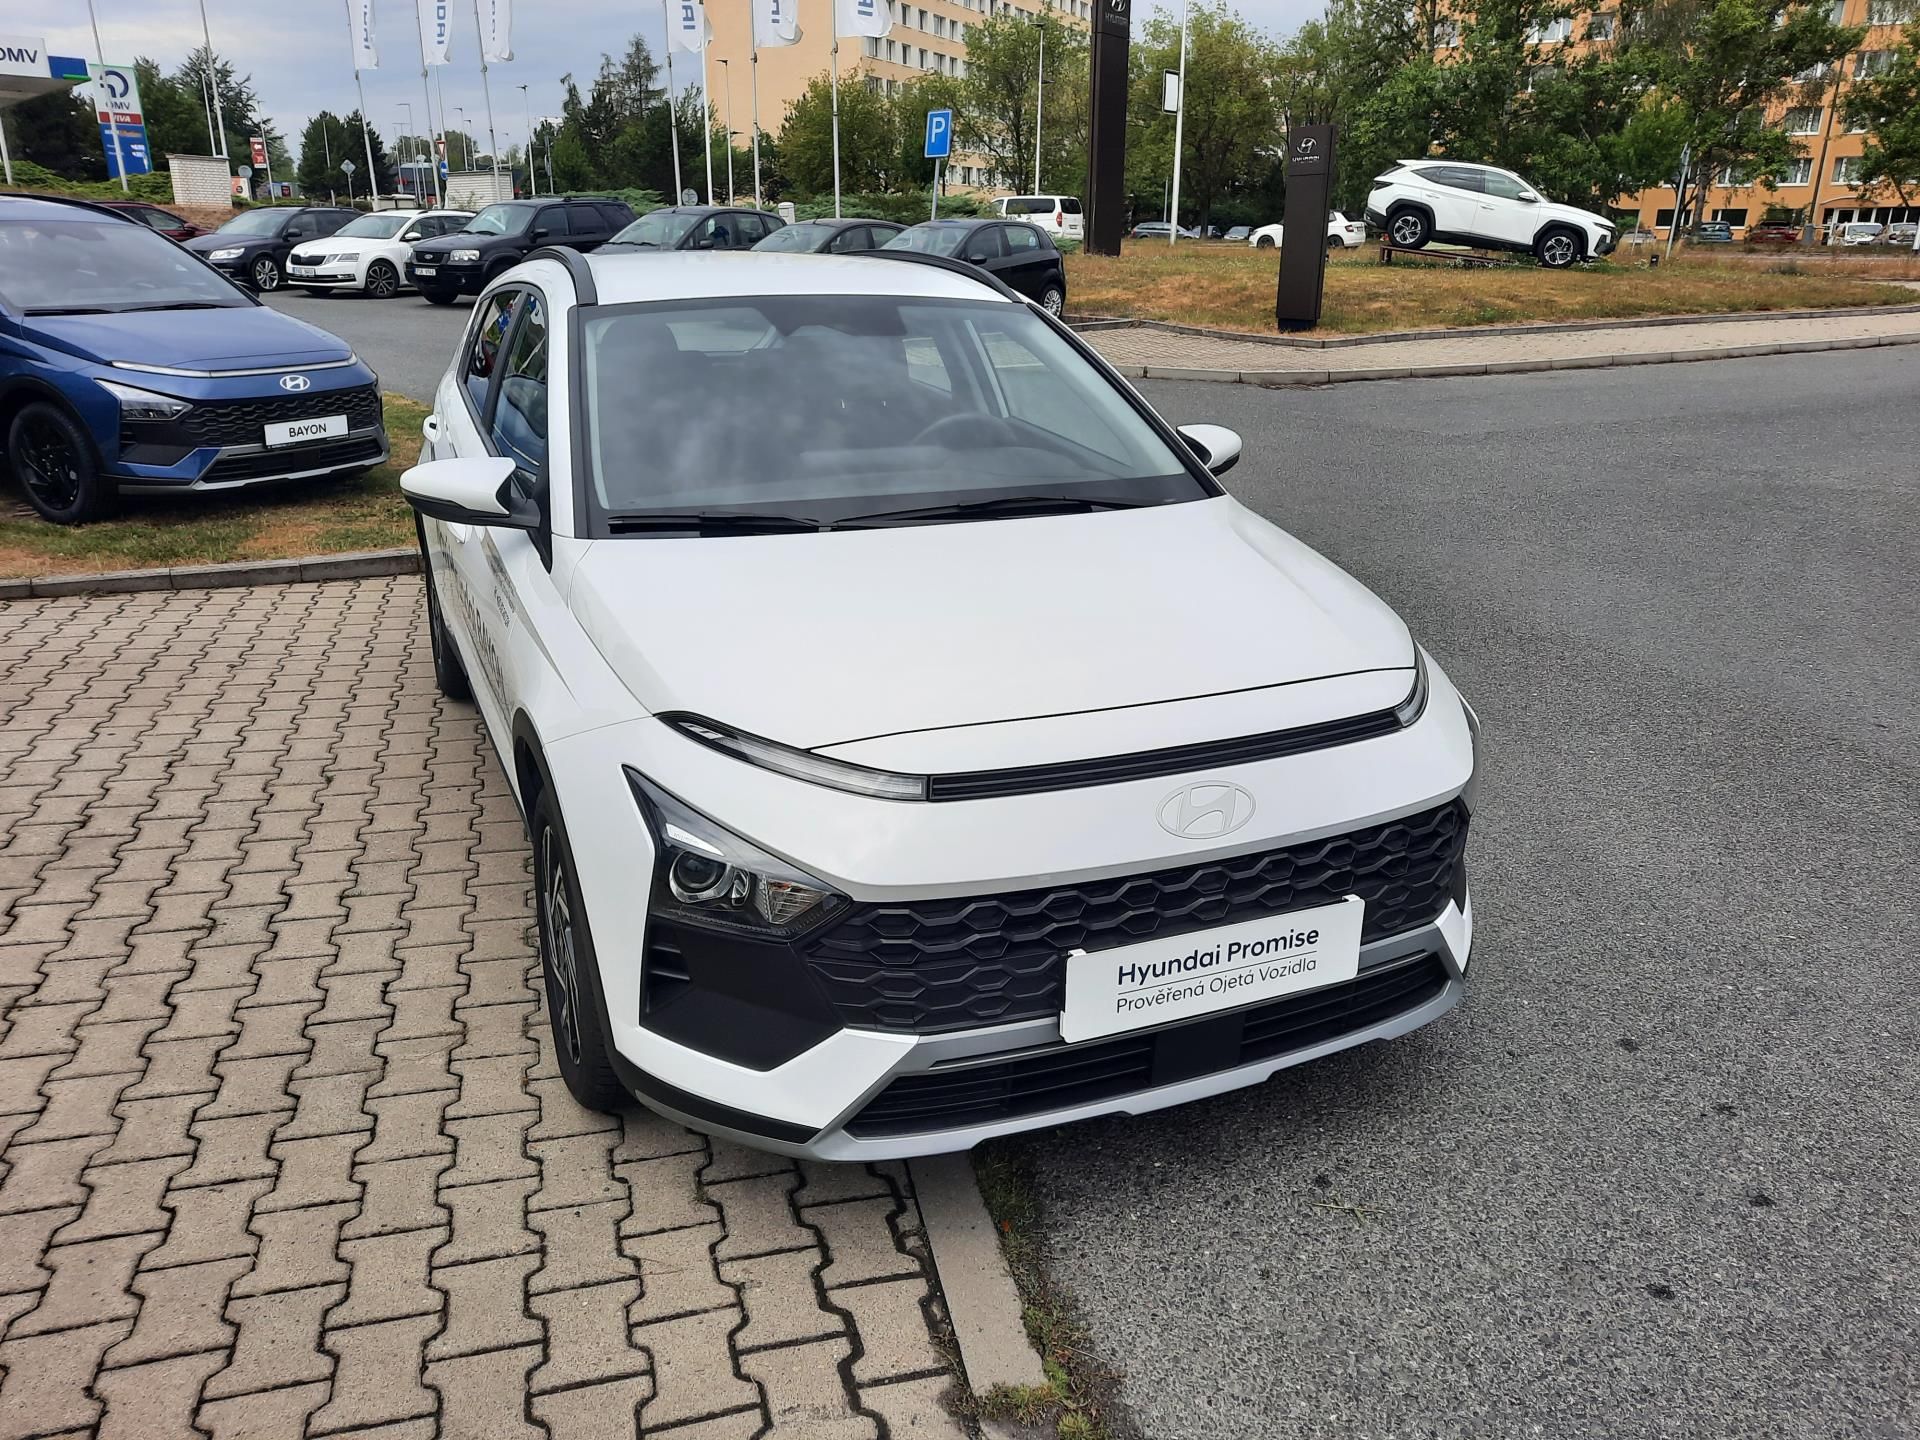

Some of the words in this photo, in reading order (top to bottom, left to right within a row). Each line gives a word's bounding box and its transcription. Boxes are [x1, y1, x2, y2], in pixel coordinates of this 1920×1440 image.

[931, 116, 946, 144] P
[288, 423, 327, 438] BAYON
[1117, 944, 1221, 985] Hyundai
[1227, 928, 1320, 962] Promise
[1116, 980, 1205, 1014] Prověřená
[1209, 969, 1254, 994] Ojetá
[1258, 957, 1317, 982] Vozidla
